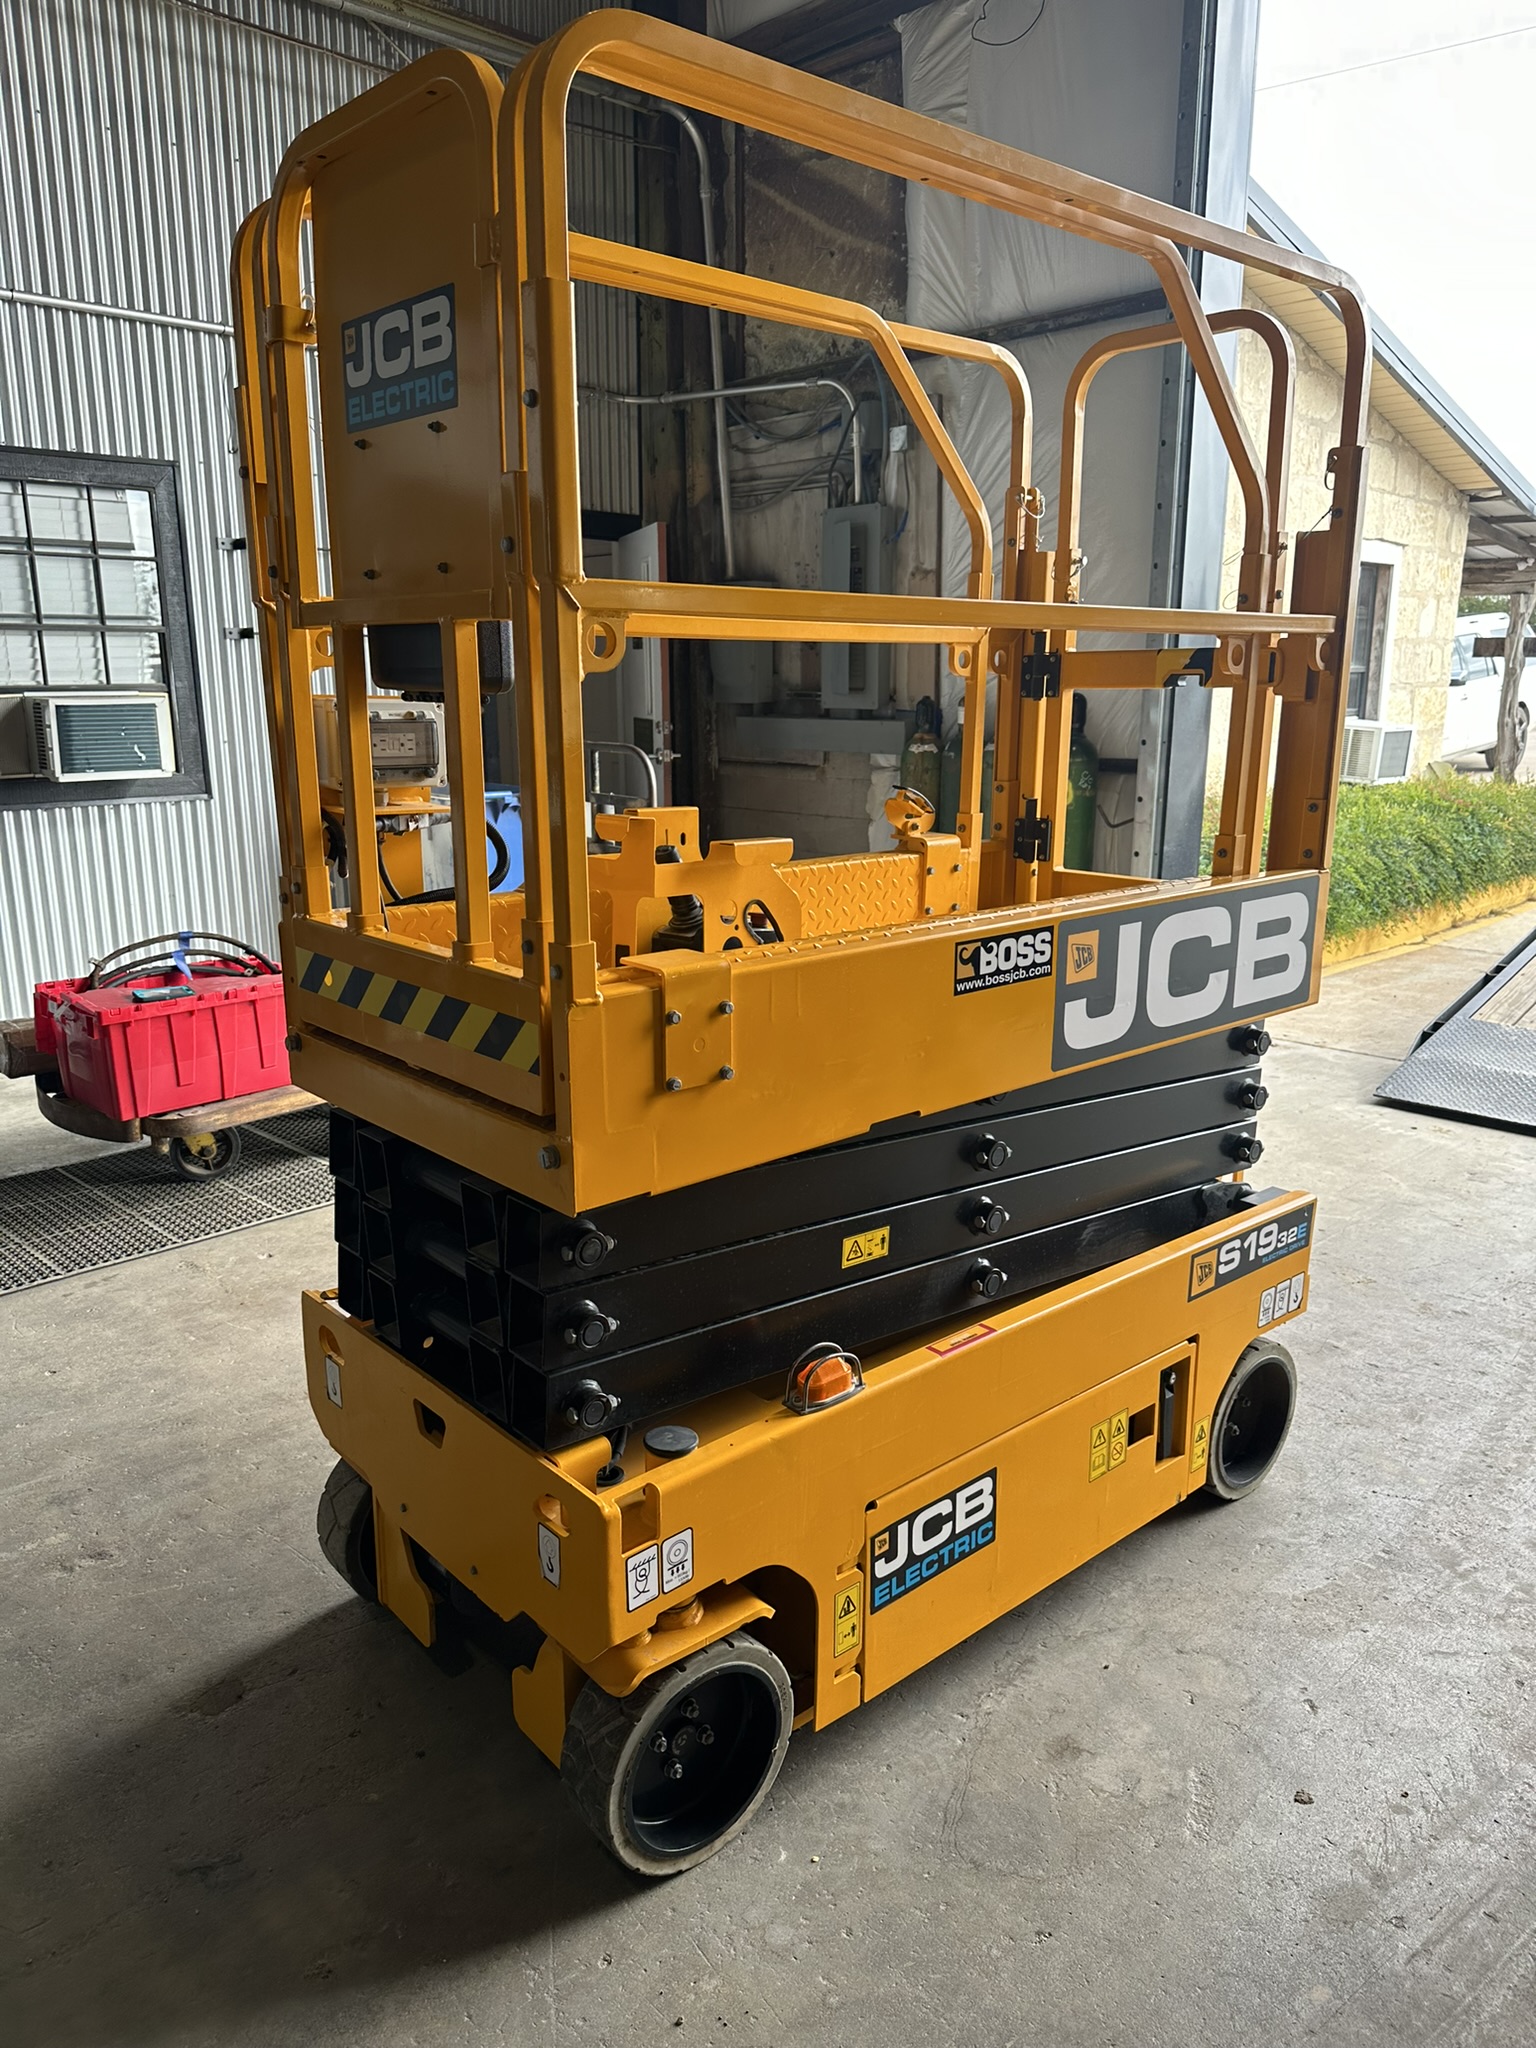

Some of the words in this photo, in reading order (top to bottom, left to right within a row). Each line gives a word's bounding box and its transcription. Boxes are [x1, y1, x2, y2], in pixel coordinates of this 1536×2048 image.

[346, 295, 453, 388] JCB
[348, 370, 455, 425] ELECTRIC
[956, 963, 1051, 992] www.bossjcb.com
[979, 931, 1052, 975] BOSS
[1064, 894, 1310, 1050] JCB
[1075, 946, 1095, 970] JCB
[1198, 1263, 1213, 1283] JCB
[1261, 1247, 1289, 1264] ELECTRIC
[1289, 1239, 1306, 1254] DRIVE
[874, 1476, 994, 1579] JCB
[874, 1521, 993, 1607] ELECTRIC
